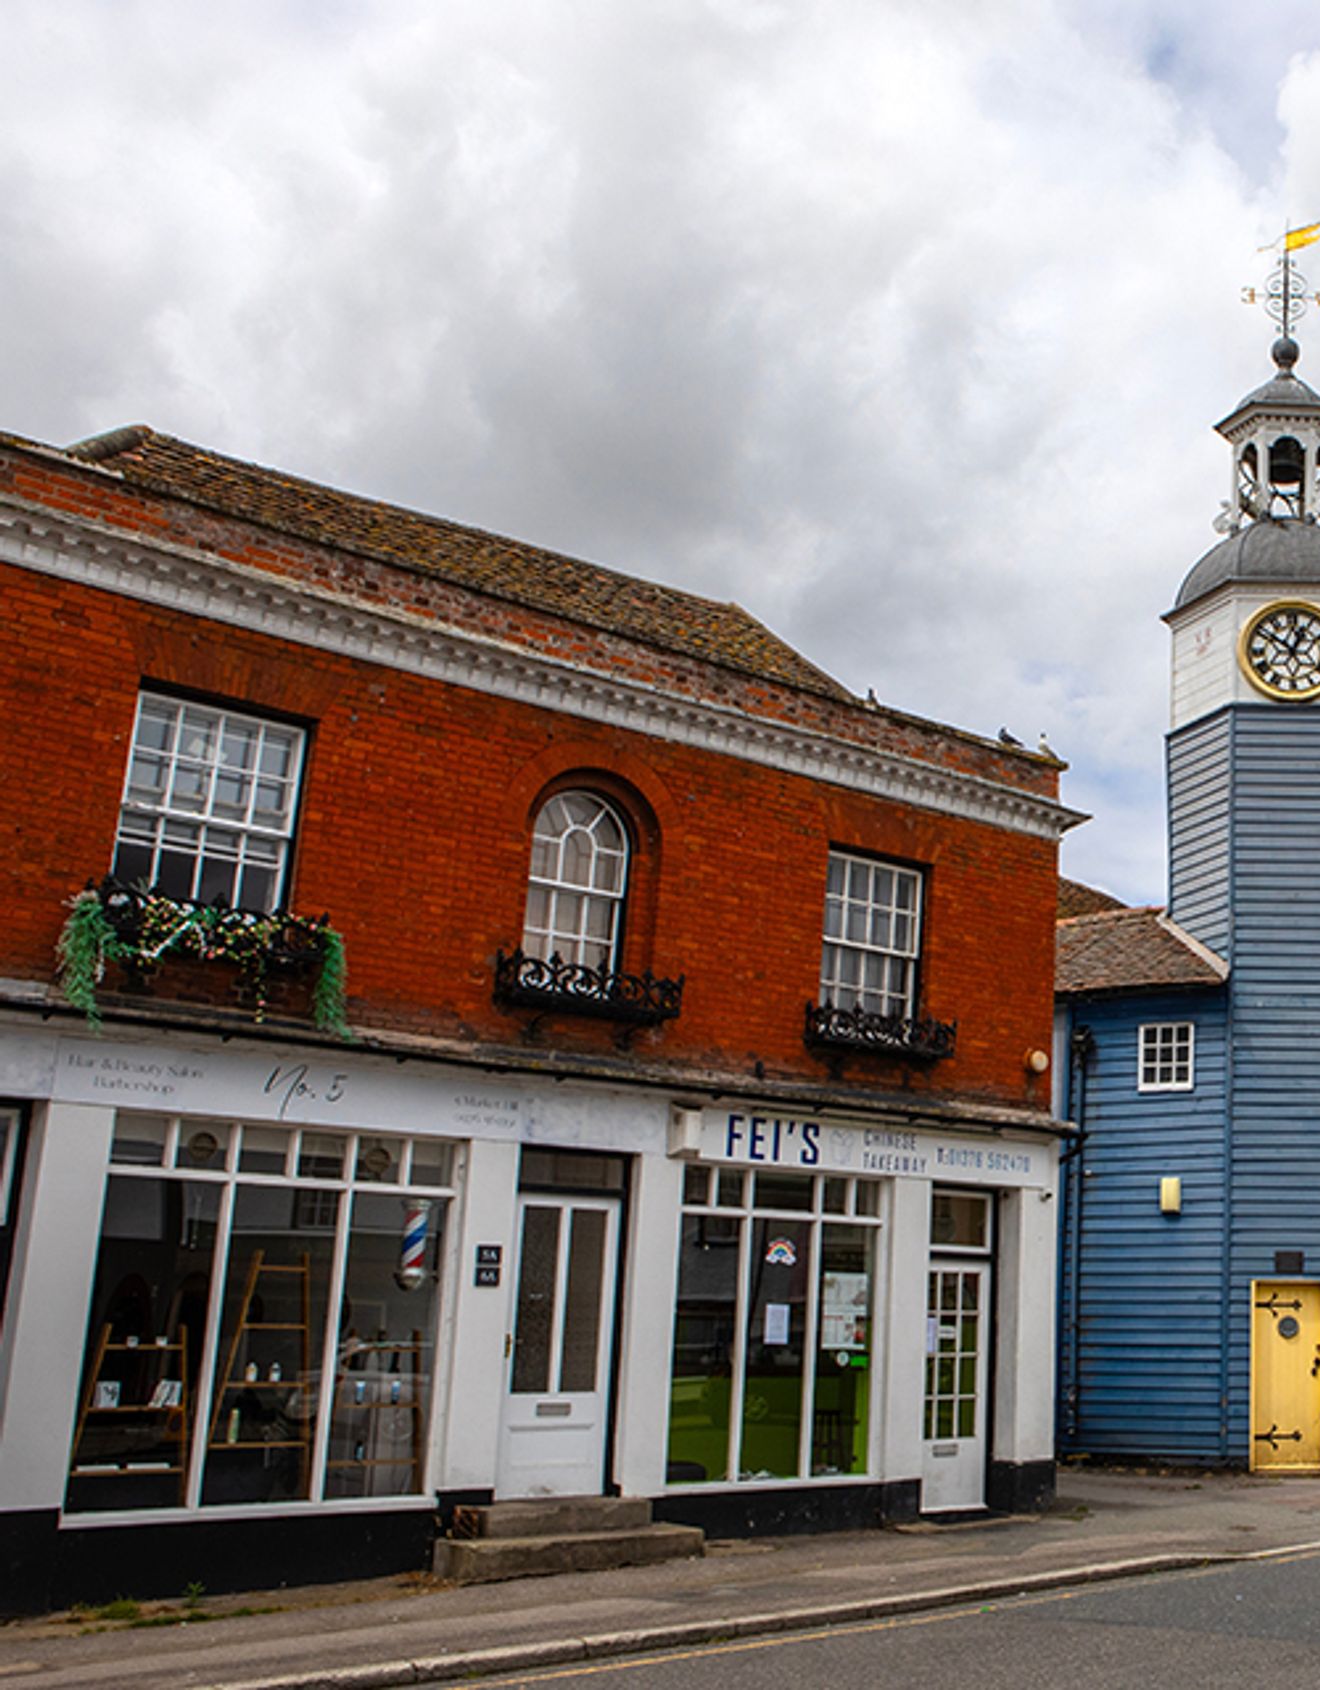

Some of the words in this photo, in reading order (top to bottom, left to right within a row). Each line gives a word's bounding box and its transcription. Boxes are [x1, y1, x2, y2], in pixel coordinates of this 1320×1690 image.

[114, 1058, 162, 1077] Beauty
[167, 1064, 204, 1079] Salon
[93, 1075, 175, 1095] Barbershop
[325, 1073, 348, 1102] 5
[726, 1114, 821, 1165] FEI'S
[863, 1129, 918, 1151] CHINESE
[862, 1151, 928, 1173] TAKEAWAY
